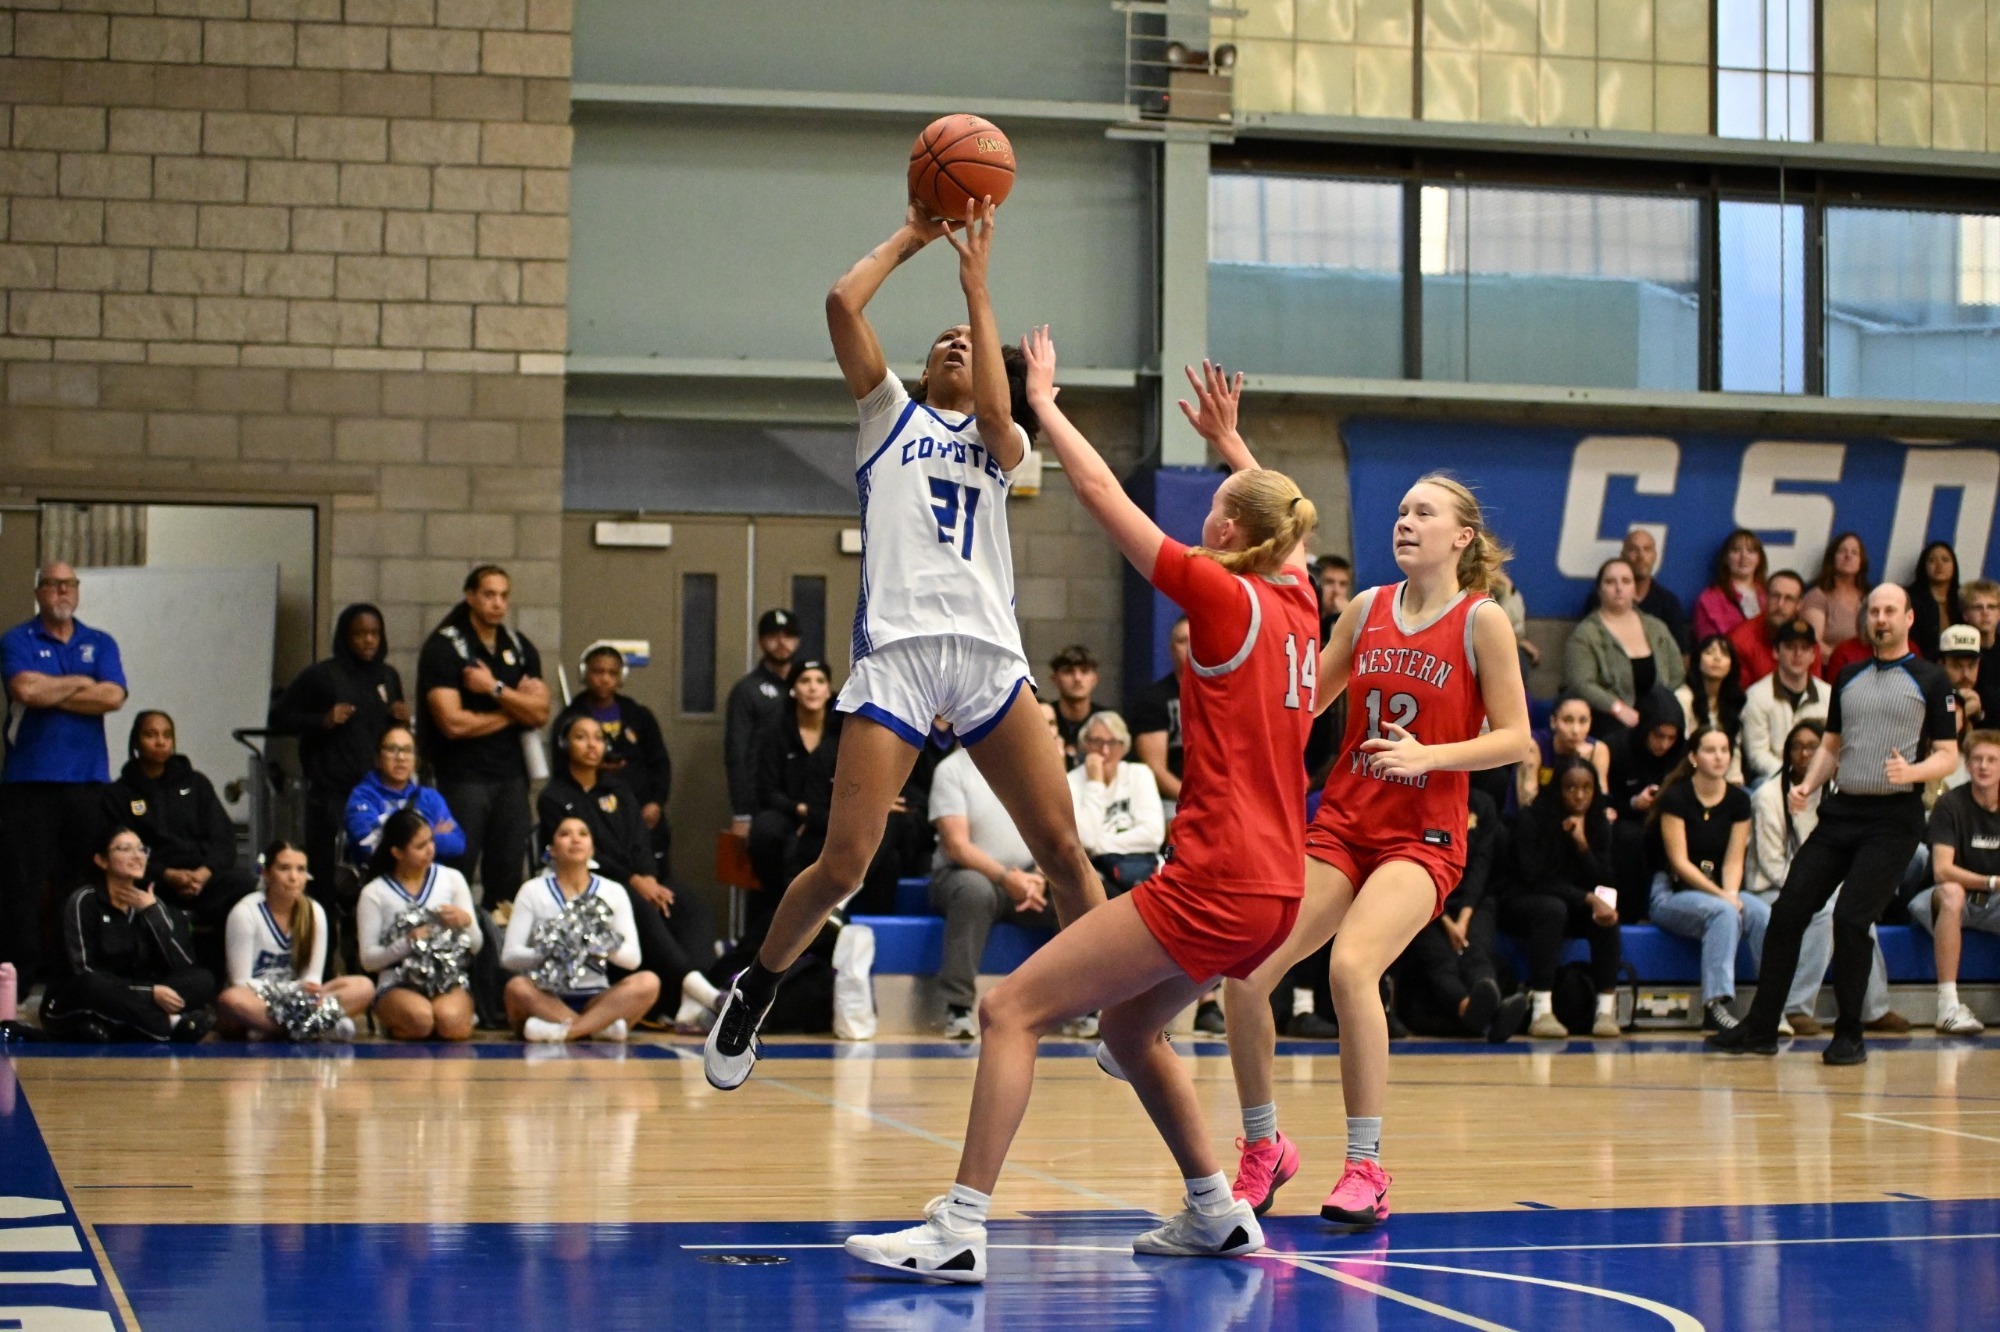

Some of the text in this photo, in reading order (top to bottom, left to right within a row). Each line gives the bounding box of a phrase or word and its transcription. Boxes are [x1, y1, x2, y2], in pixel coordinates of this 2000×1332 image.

[901, 436, 1005, 488] COYOTE
[928, 476, 981, 561] 21
[1284, 633, 1317, 712] 14
[1357, 648, 1453, 689] WESTERN
[1365, 688, 1418, 742] 12
